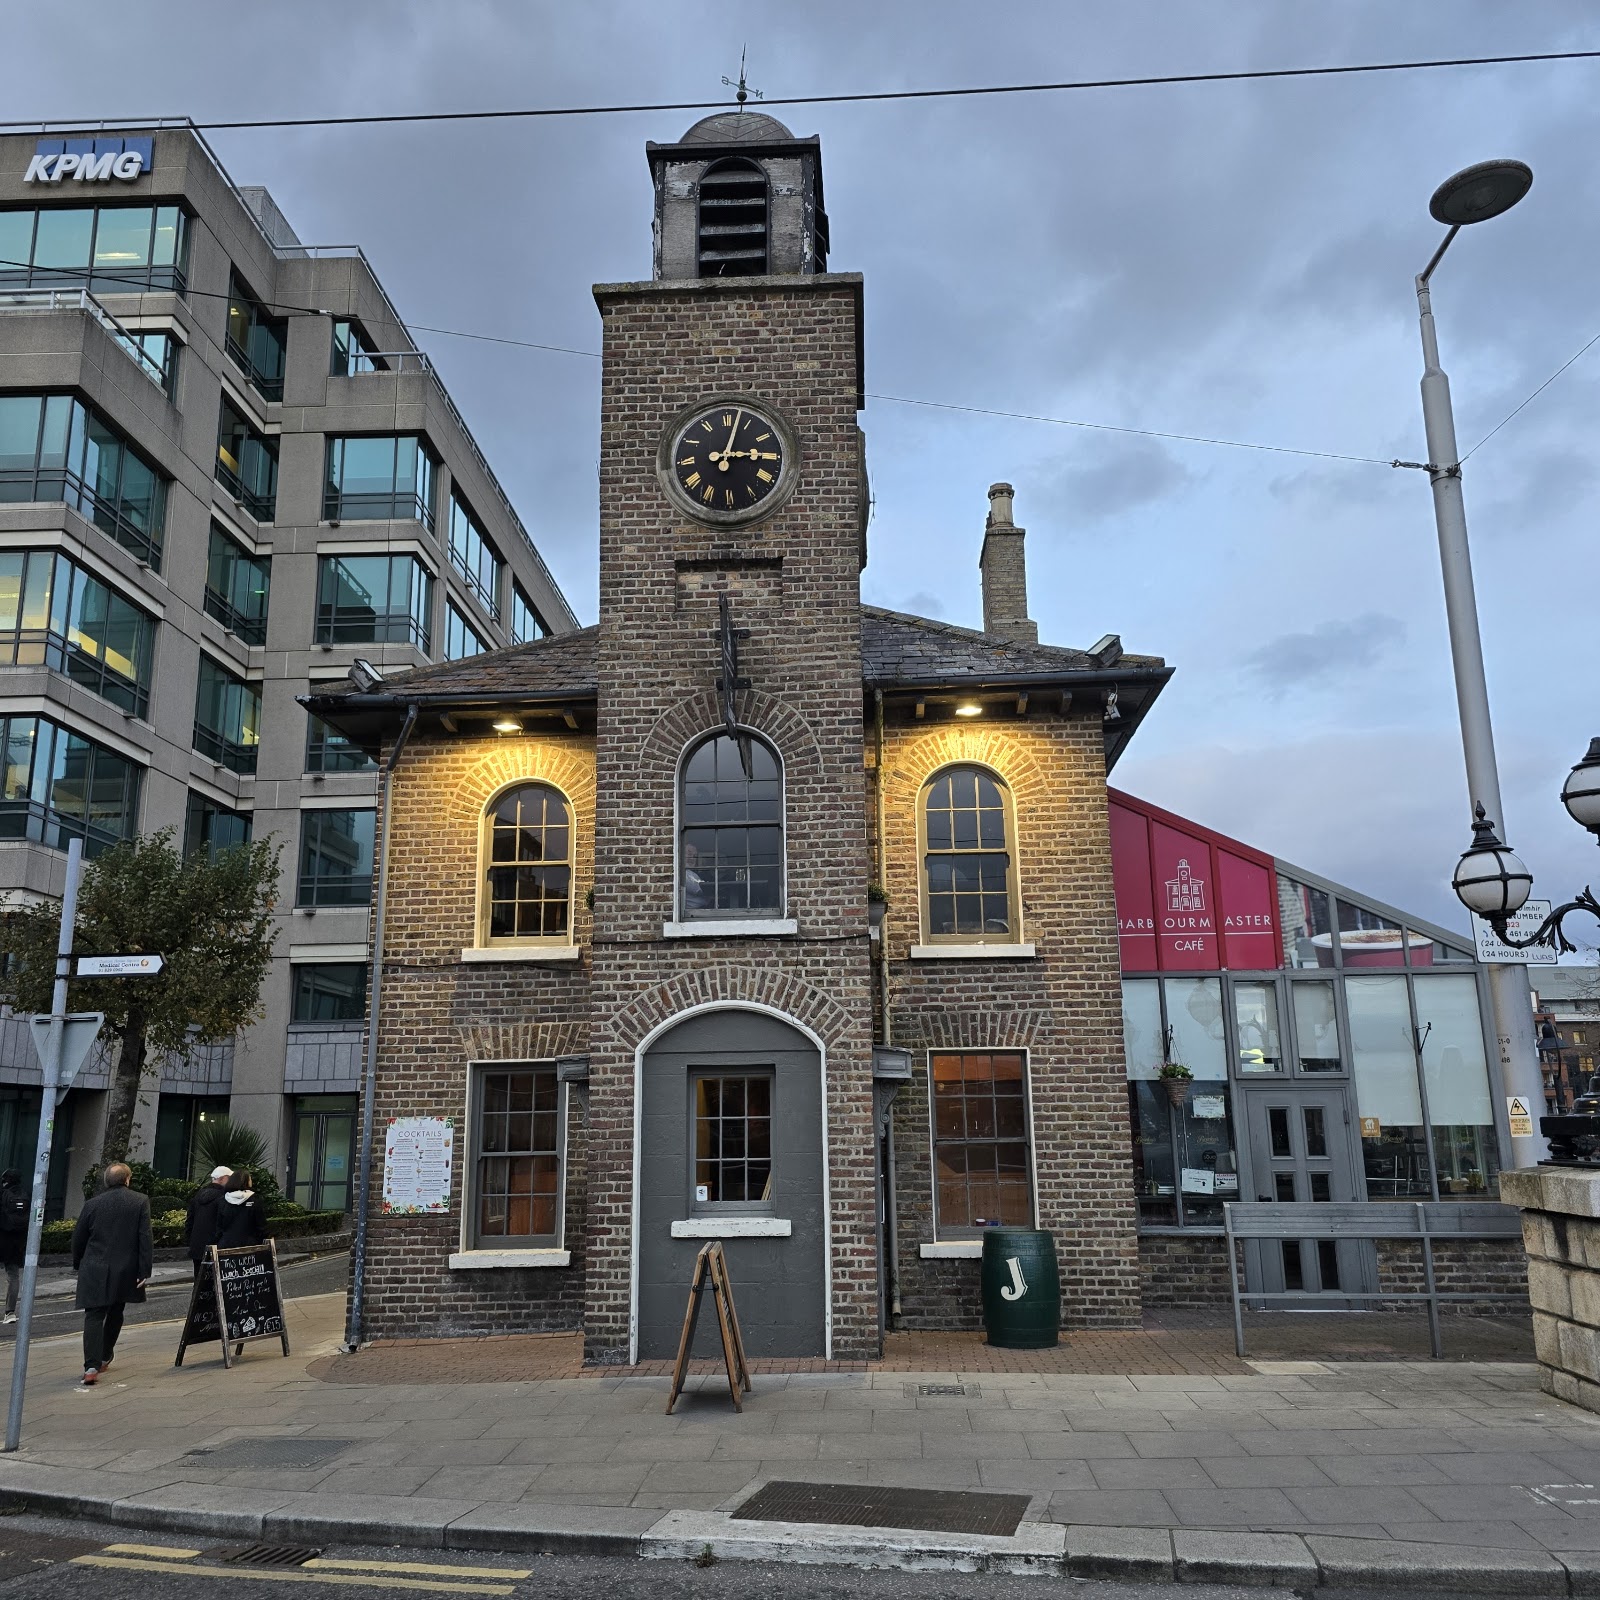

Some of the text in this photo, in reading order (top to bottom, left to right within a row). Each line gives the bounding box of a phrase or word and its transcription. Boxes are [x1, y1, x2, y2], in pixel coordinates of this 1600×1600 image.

[23, 151, 144, 183] KPMG
[1174, 938, 1204, 951] CAFÉ
[1498, 950, 1529, 958] HOURS)
[398, 1130, 442, 1138] COCKTAILS
